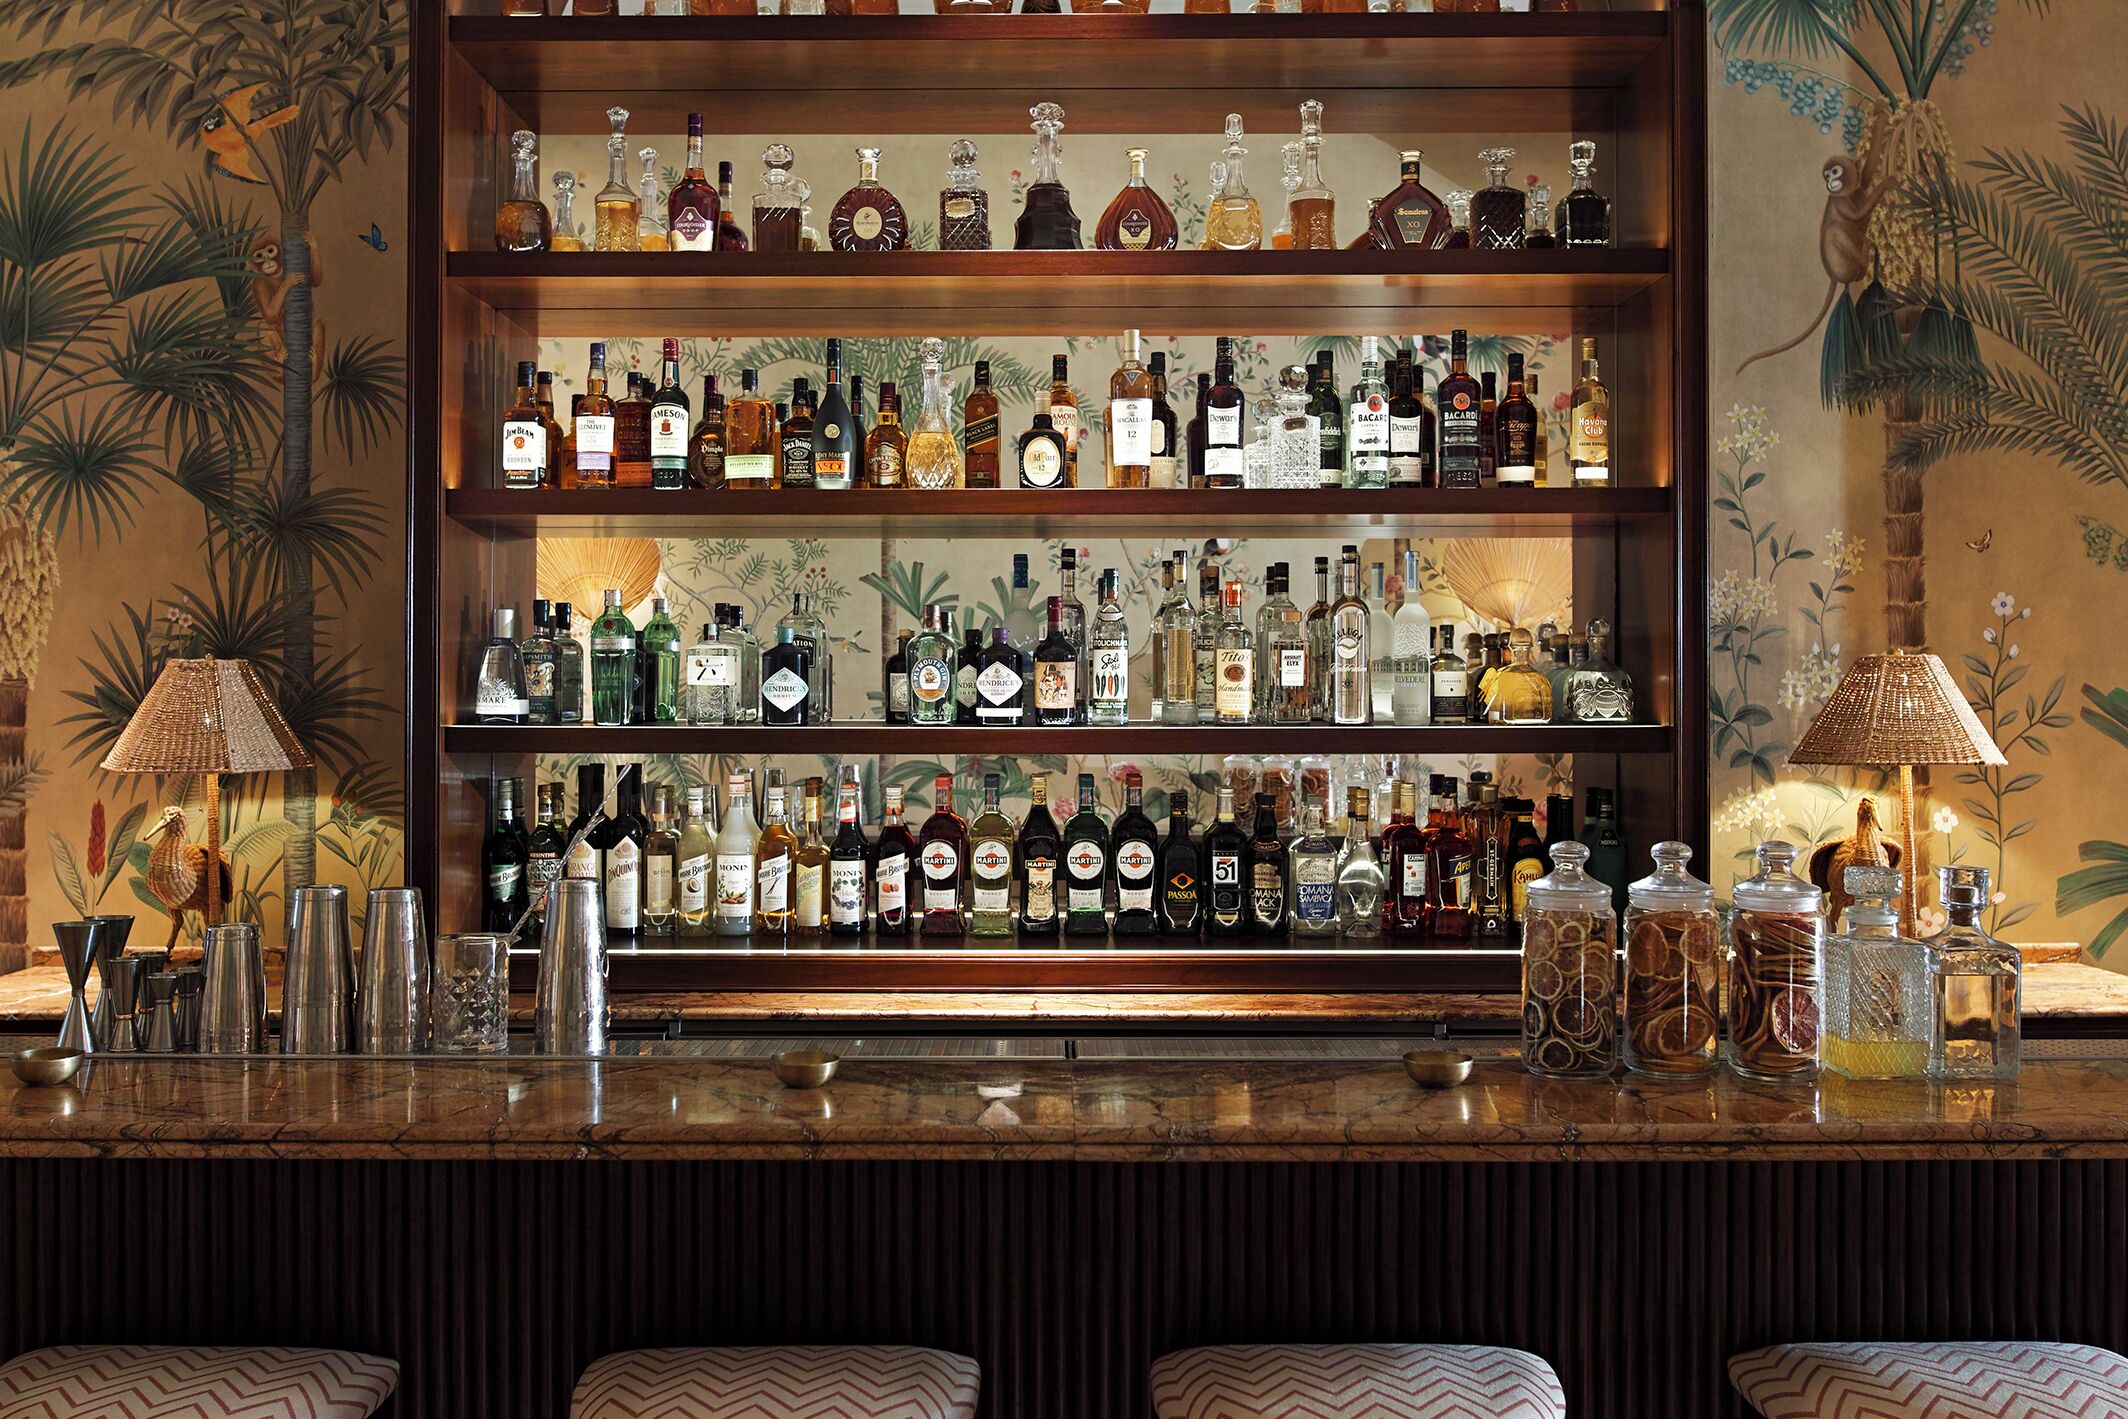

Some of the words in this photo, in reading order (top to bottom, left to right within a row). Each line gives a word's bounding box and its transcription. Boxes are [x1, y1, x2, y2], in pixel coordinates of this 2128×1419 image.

[1397, 207, 1429, 216] Samalens
[1406, 221, 1421, 229] XO
[1358, 413, 1388, 422] BACARD
[1579, 416, 1608, 427] Havana
[505, 428, 517, 440] JIM
[517, 426, 535, 440] BEAM
[1127, 431, 1137, 439] 12
[1584, 426, 1604, 435] Club
[783, 442, 796, 453] JACK
[793, 639, 814, 647] ATION
[1215, 861, 1236, 881] 51
[1297, 885, 1335, 896] ROMANA
